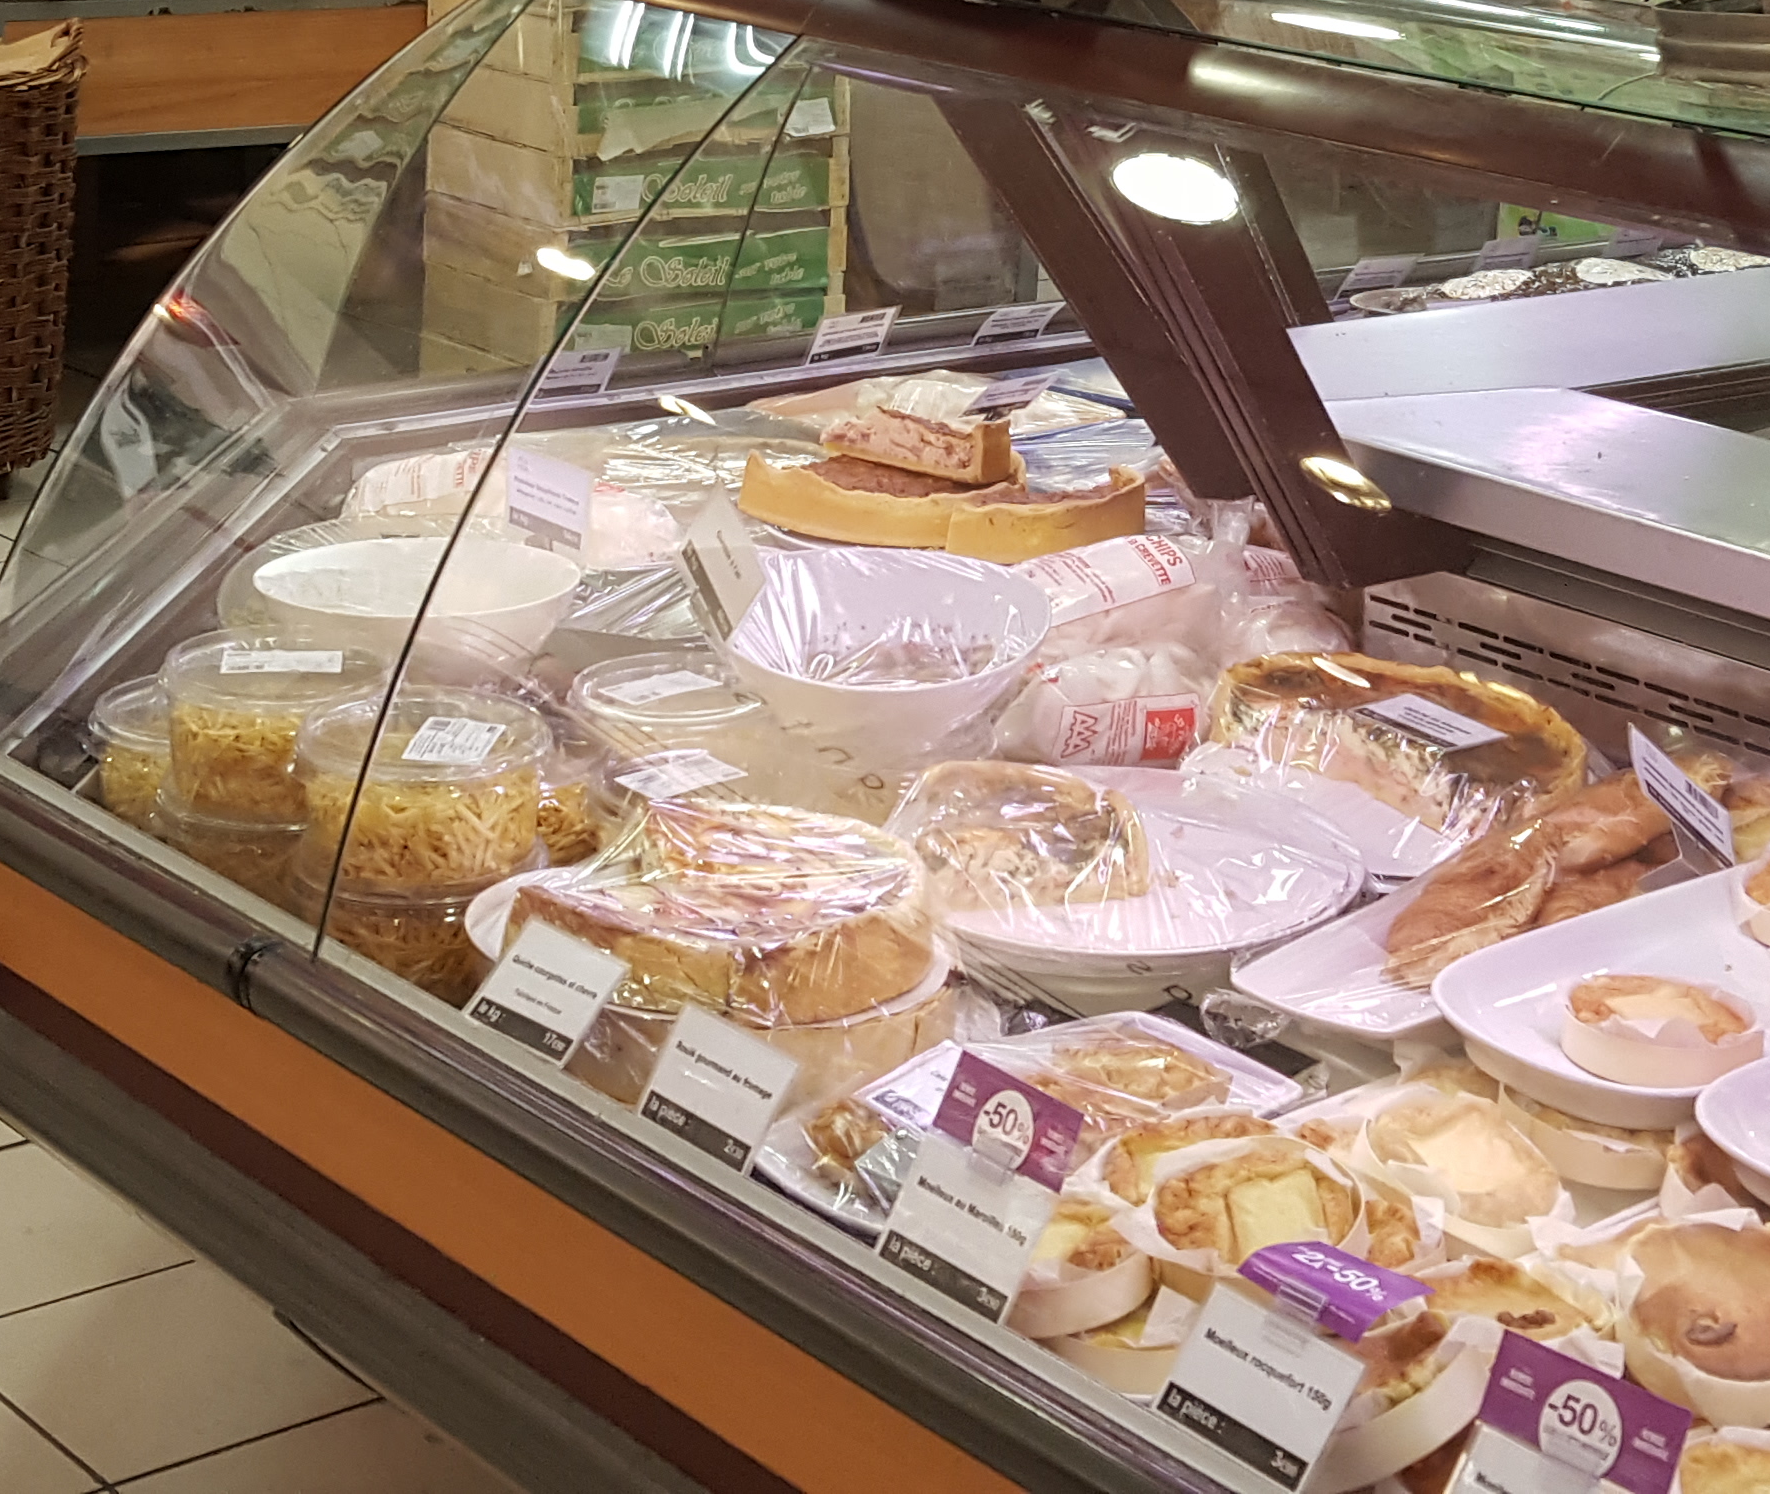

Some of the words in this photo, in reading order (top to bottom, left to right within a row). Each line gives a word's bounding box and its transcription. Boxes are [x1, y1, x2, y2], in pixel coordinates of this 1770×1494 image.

[1135, 543, 1172, 586] CREVETTE
[983, 1101, 1030, 1146] -50%
[1547, 1393, 1618, 1447] -50%
